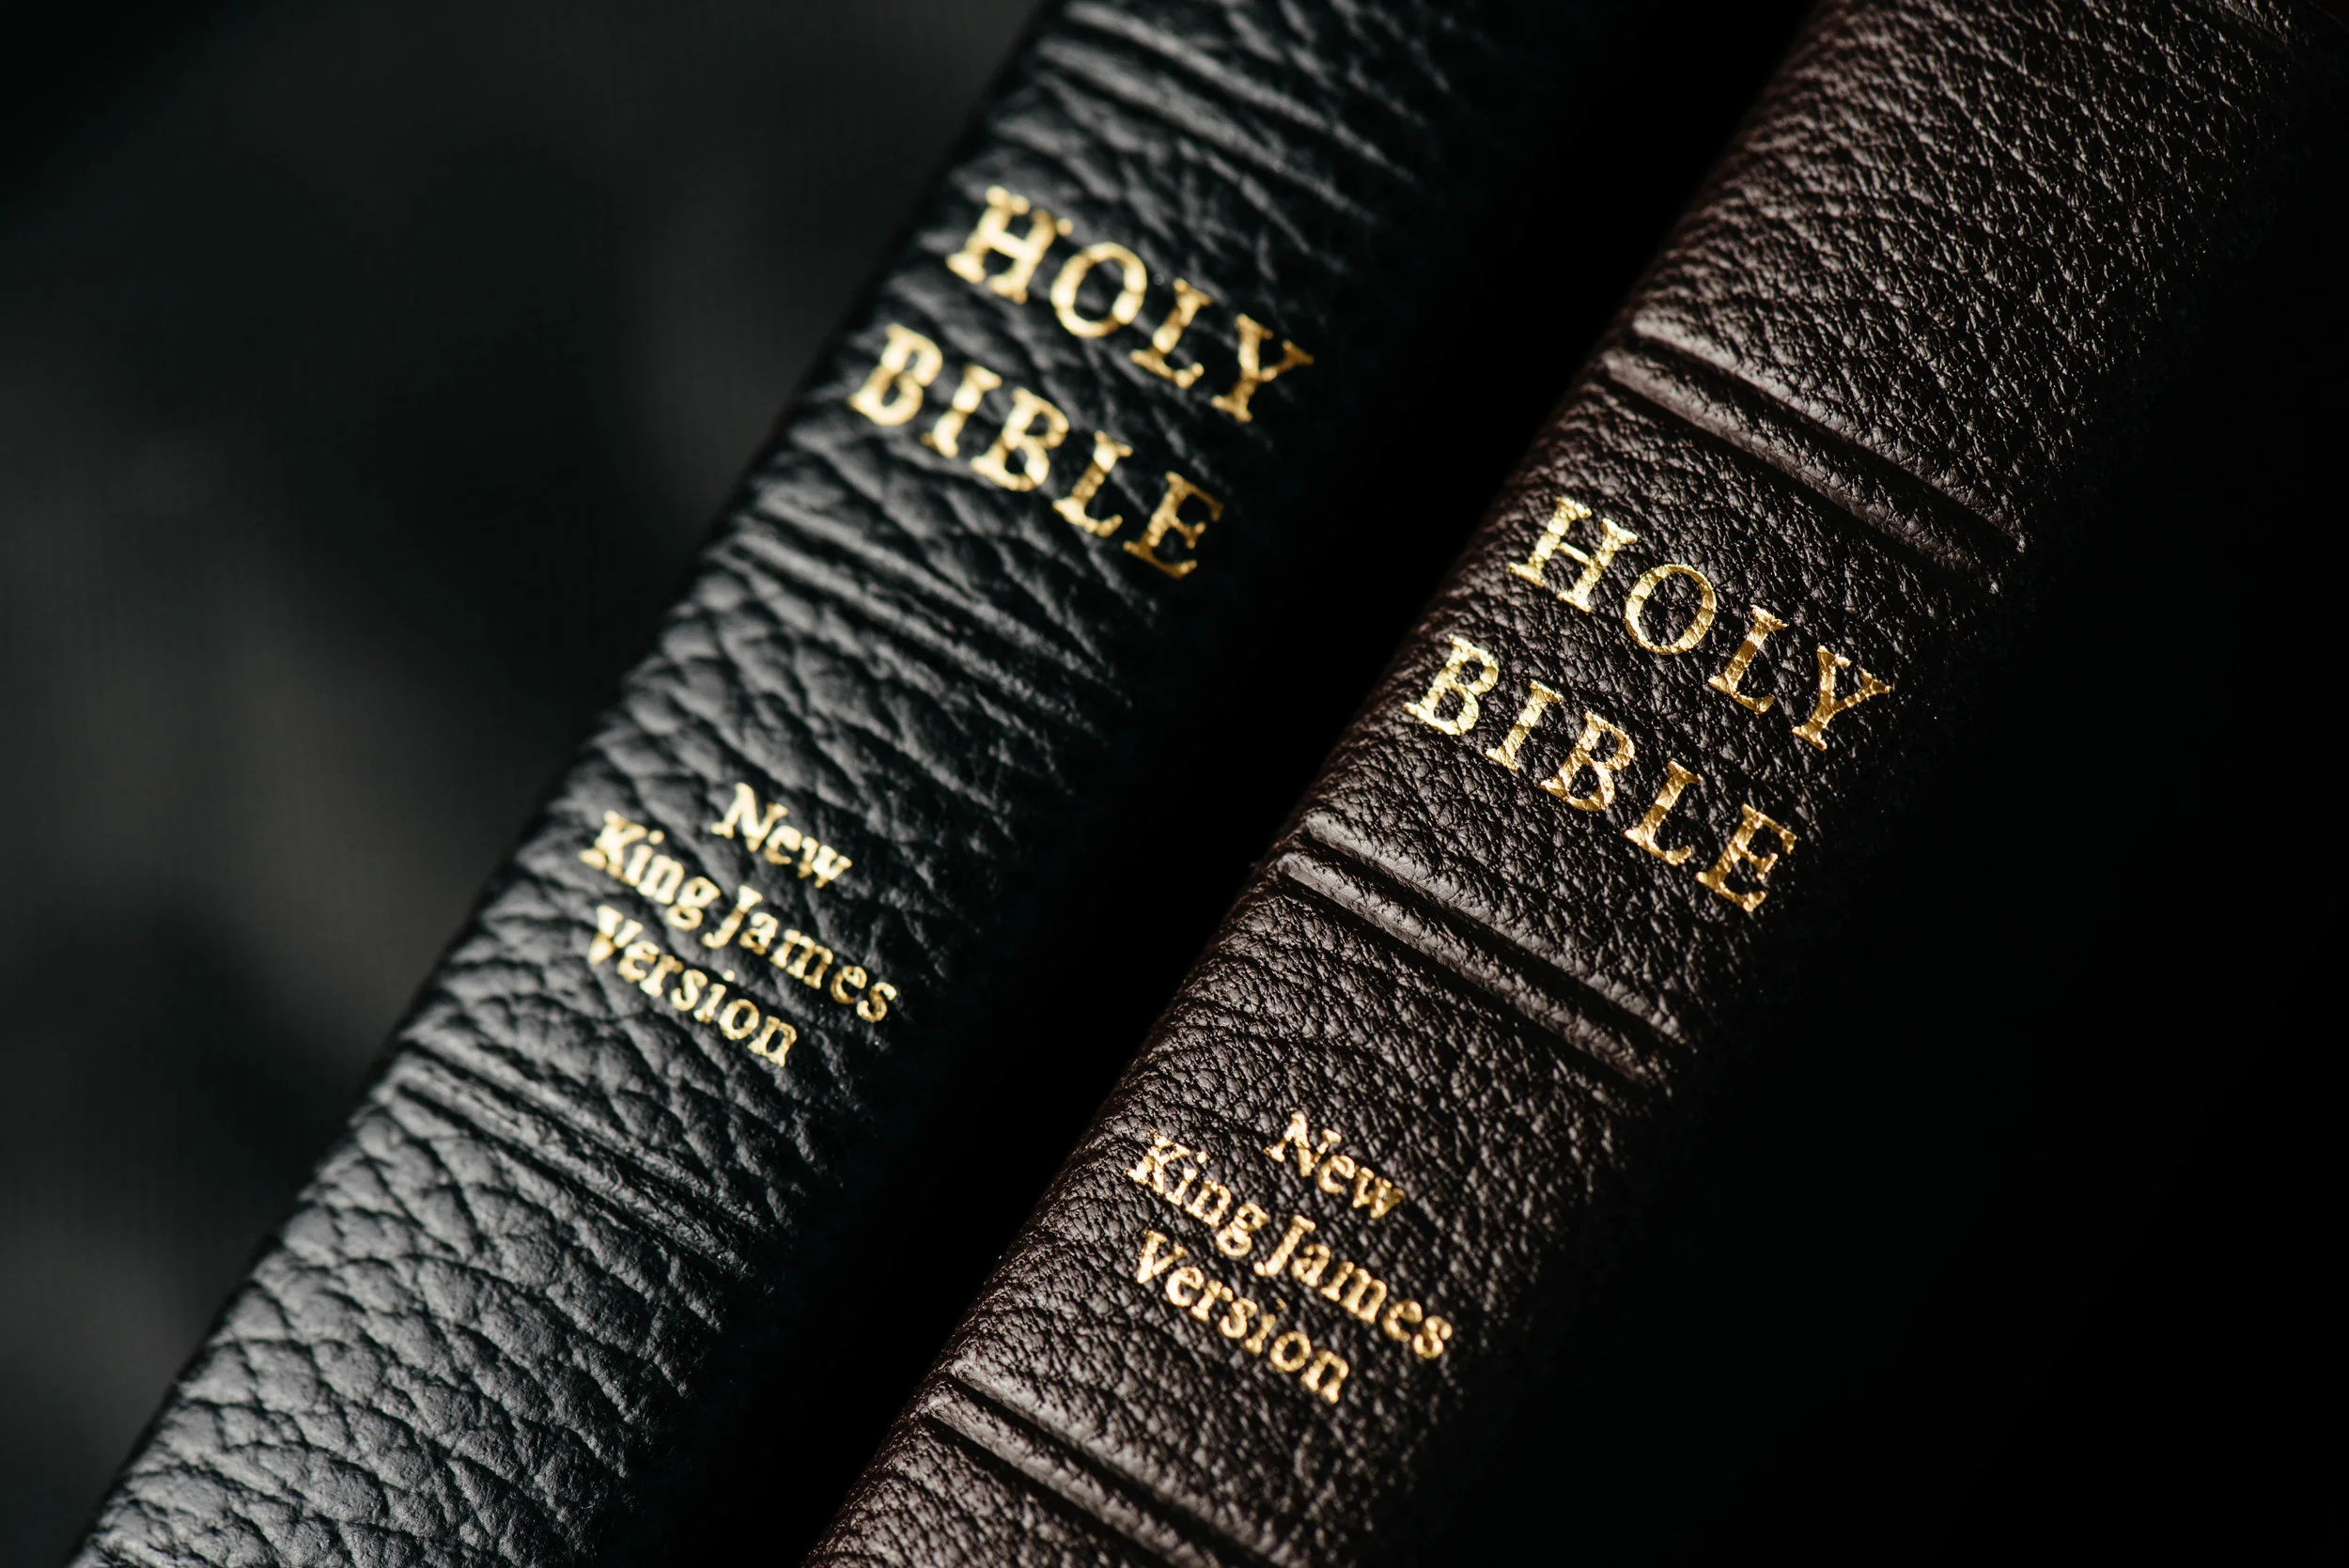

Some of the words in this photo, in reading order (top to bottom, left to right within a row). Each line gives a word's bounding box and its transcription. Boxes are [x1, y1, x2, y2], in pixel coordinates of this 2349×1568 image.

[945, 185, 1315, 423] HOLY
[848, 323, 1223, 580] BIBLE
[1507, 496, 1892, 752] HOLY
[710, 782, 853, 889] New
[1402, 633, 1798, 913] BIBLE
[578, 809, 722, 931] King
[701, 884, 897, 1023] James
[587, 905, 798, 1068] Version
[1124, 1129, 1269, 1258] King
[1252, 1213, 1454, 1360] James
[1262, 1110, 1406, 1219] New
[1136, 1228, 1350, 1405] Version
